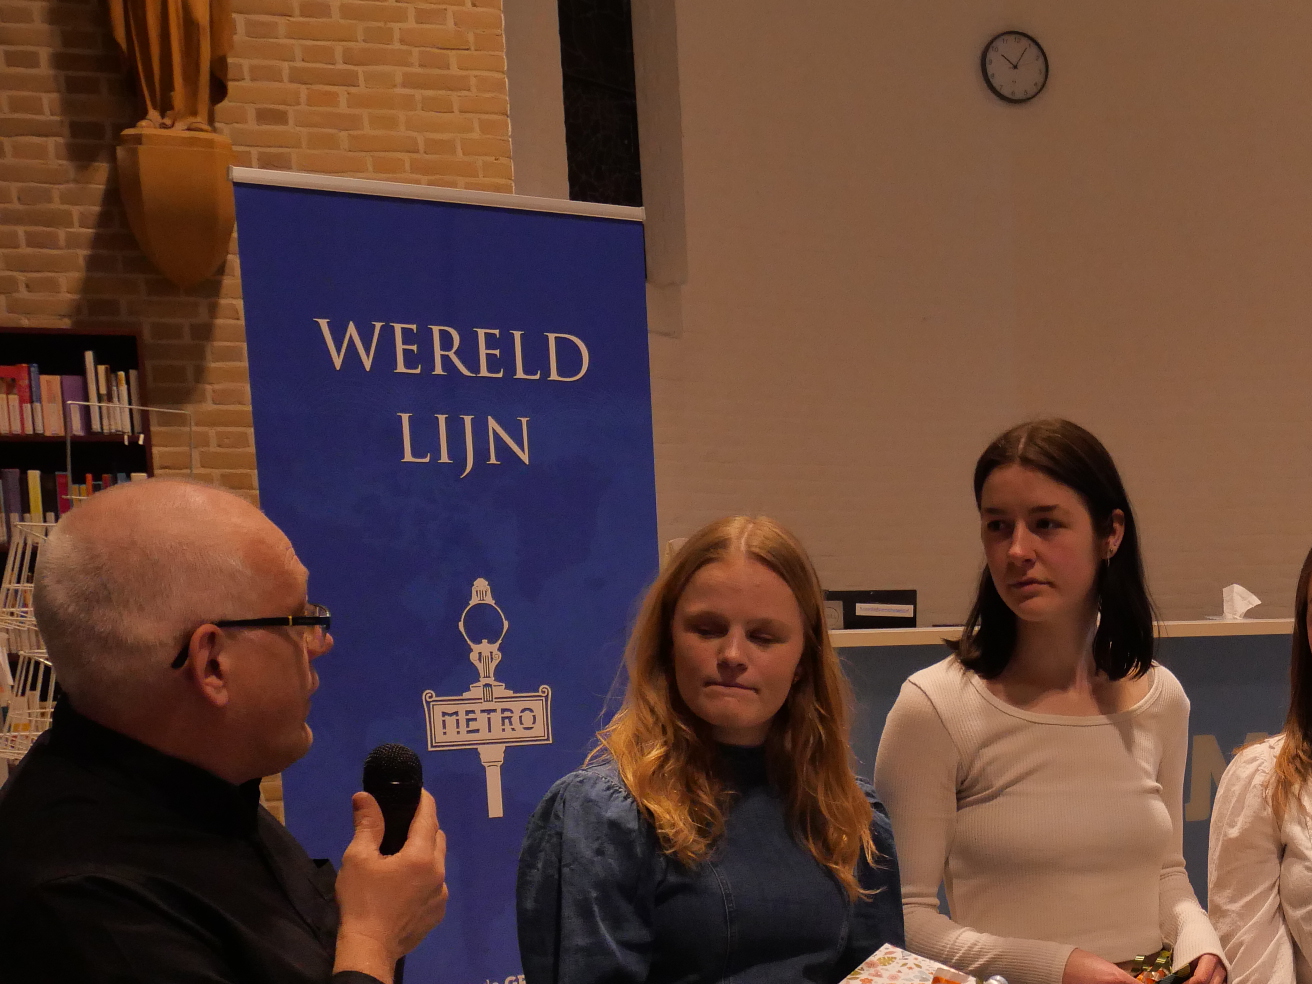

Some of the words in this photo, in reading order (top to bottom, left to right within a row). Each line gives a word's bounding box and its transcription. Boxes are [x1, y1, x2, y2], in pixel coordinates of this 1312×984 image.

[313, 319, 590, 382] WERELD
[397, 413, 530, 479] LIJN
[441, 707, 537, 735] METRO
